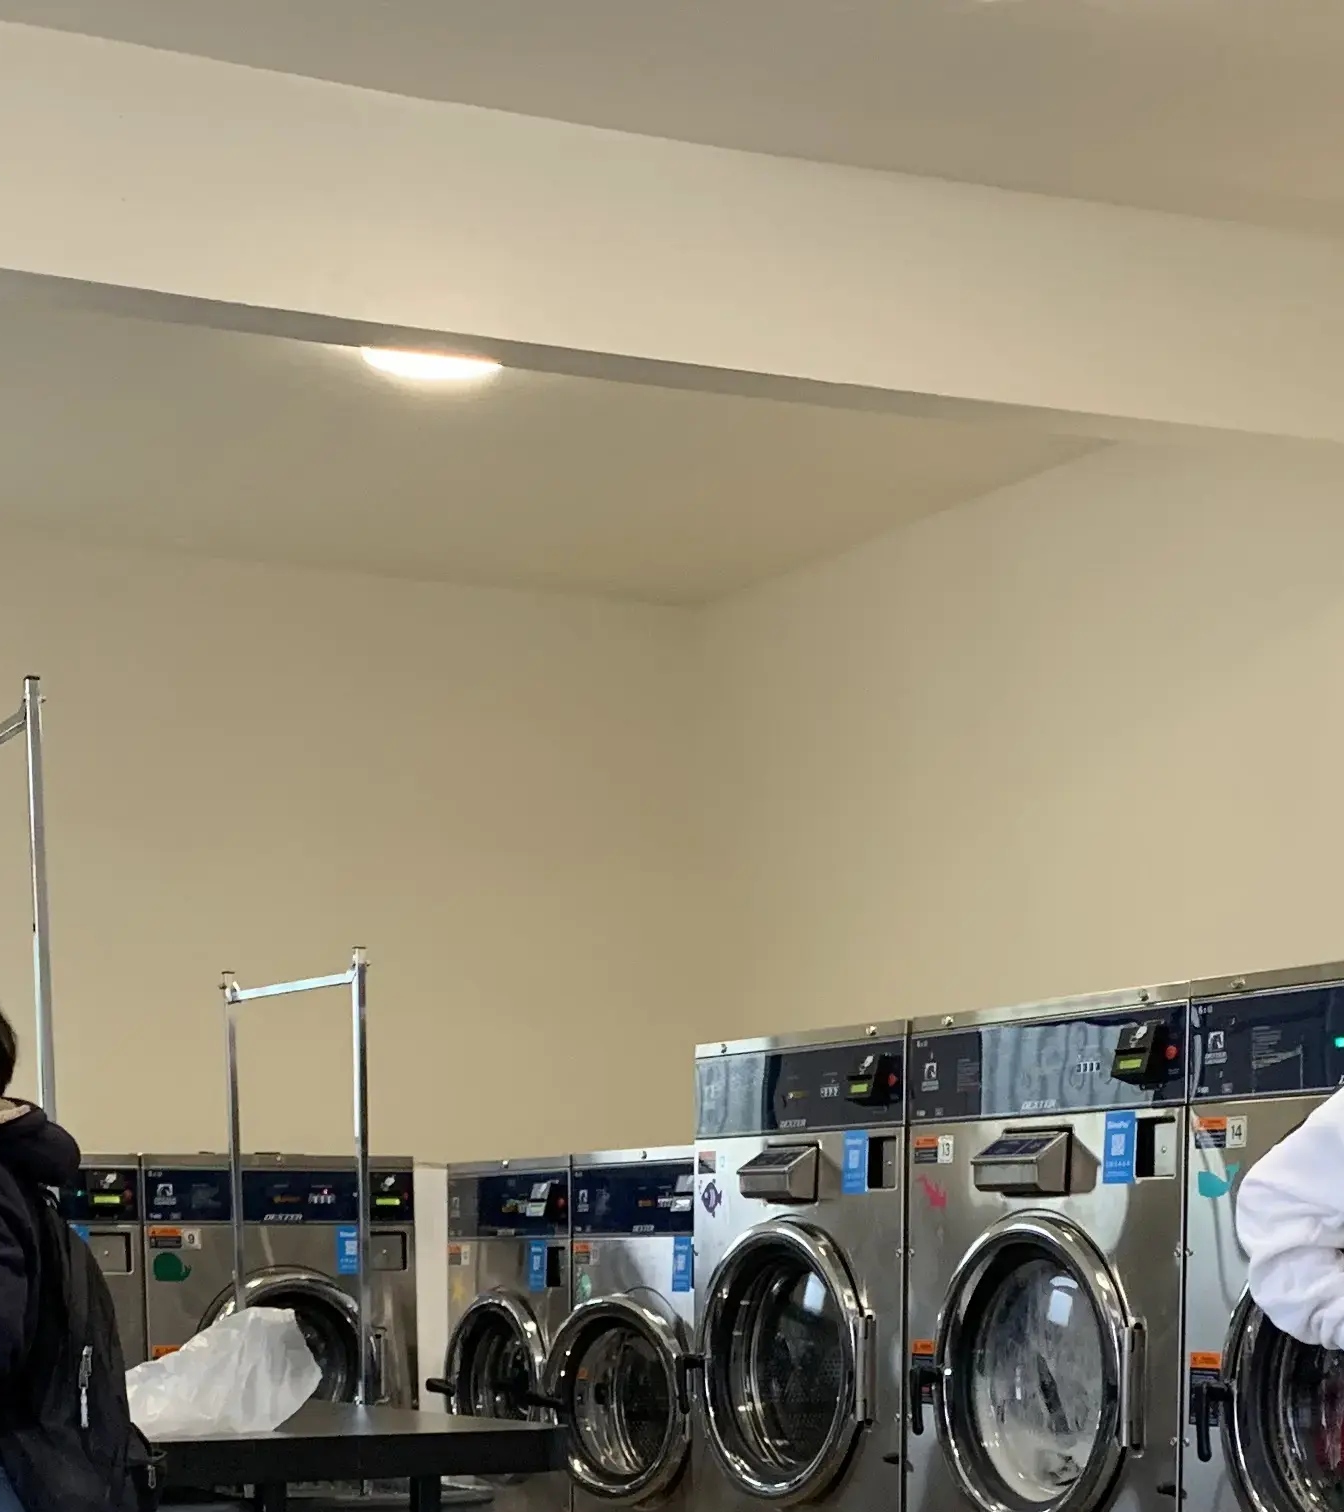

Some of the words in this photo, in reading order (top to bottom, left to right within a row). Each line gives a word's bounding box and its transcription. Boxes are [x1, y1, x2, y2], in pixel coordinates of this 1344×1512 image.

[1021, 1100, 1056, 1110] DEXTER
[779, 1119, 806, 1128] DEXTER
[1231, 1124, 1243, 1140] 14
[942, 1143, 950, 1157] 13
[264, 1213, 303, 1221] DEXTER
[187, 1234, 195, 1245] 9
